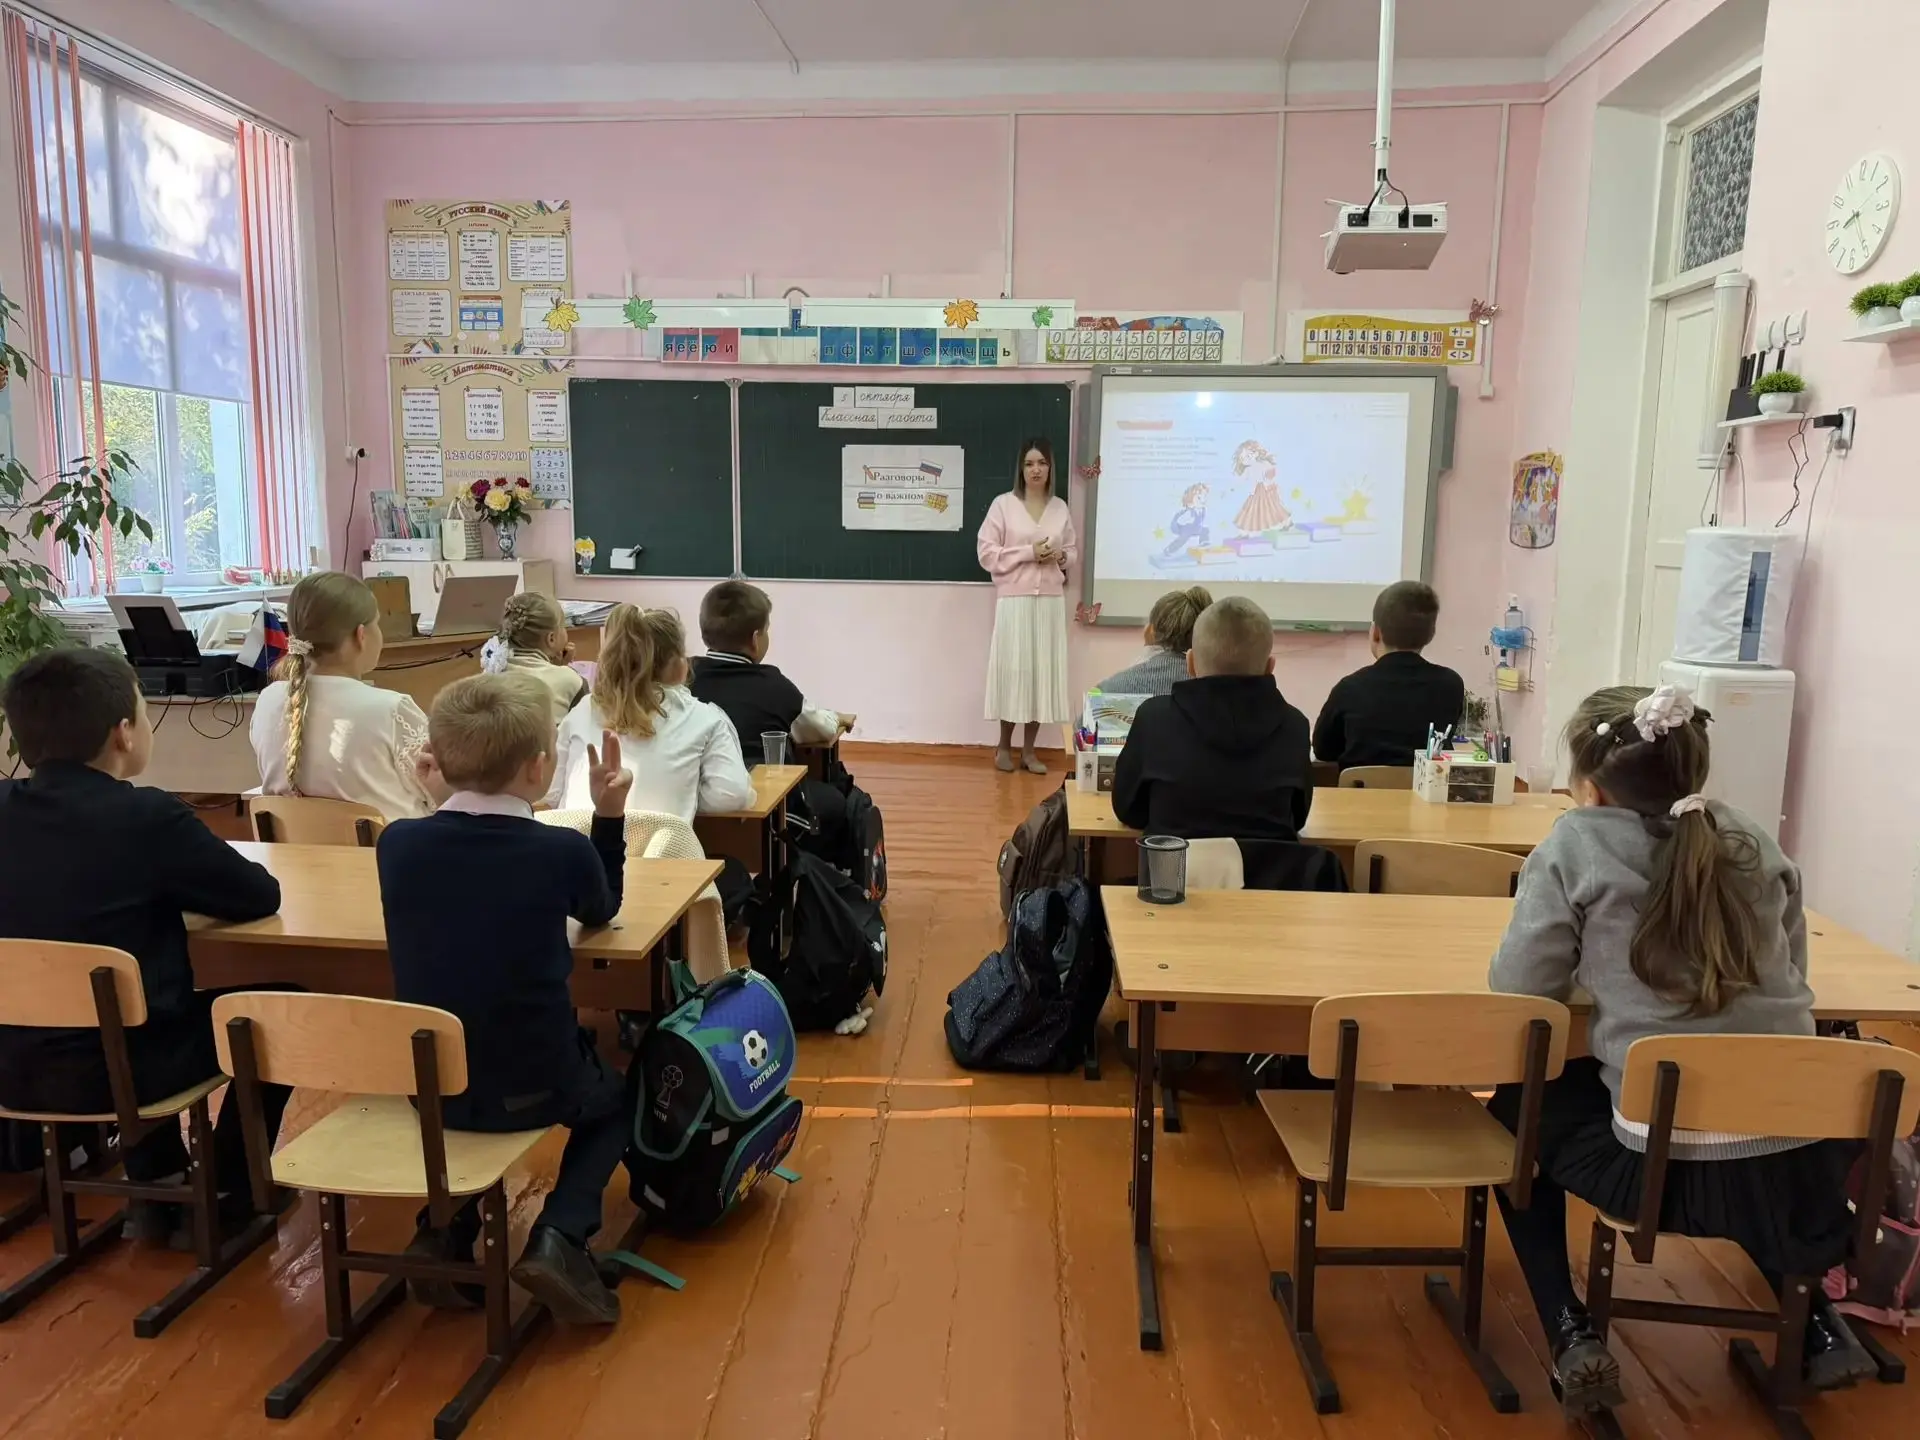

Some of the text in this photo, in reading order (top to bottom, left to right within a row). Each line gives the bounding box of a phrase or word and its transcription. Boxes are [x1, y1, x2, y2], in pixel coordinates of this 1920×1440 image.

[448, 206, 511, 221] РУССКИЙ ЯЗЫК
[1053, 332, 1220, 344] 0 1 2 3 4 5 6 7 8 9 10
[1309, 331, 1442, 342] 0 1 2 3 4 5 6 7 8 9 10
[665, 344, 673, 352] я
[678, 344, 685, 352] е
[689, 340, 697, 352] ё
[706, 344, 717, 352] ю
[825, 346, 833, 354] п
[841, 343, 853, 357] ф
[865, 347, 872, 355] к
[884, 347, 891, 355] т
[903, 347, 915, 356] ш
[923, 347, 930, 356] с
[942, 348, 949, 356] х
[954, 348, 963, 358] ц
[966, 348, 974, 356] ч
[983, 348, 996, 358] щ
[1003, 348, 1010, 356] ь
[1066, 348, 1219, 360] 11 12 13 14 15 16 17 18 19 20
[1320, 344, 1441, 357] 11 12 13 14 15 16 17 18 19 20
[452, 362, 514, 378] Математика
[860, 388, 911, 408] октября
[820, 408, 935, 430] Классная работа
[444, 450, 527, 461] 1 2 3 4 5 6 7 8 9 10
[536, 471, 540, 479] 3
[873, 471, 925, 484] Разговоры
[547, 484, 552, 492] 2
[749, 1060, 781, 1094] FOOTBALL
